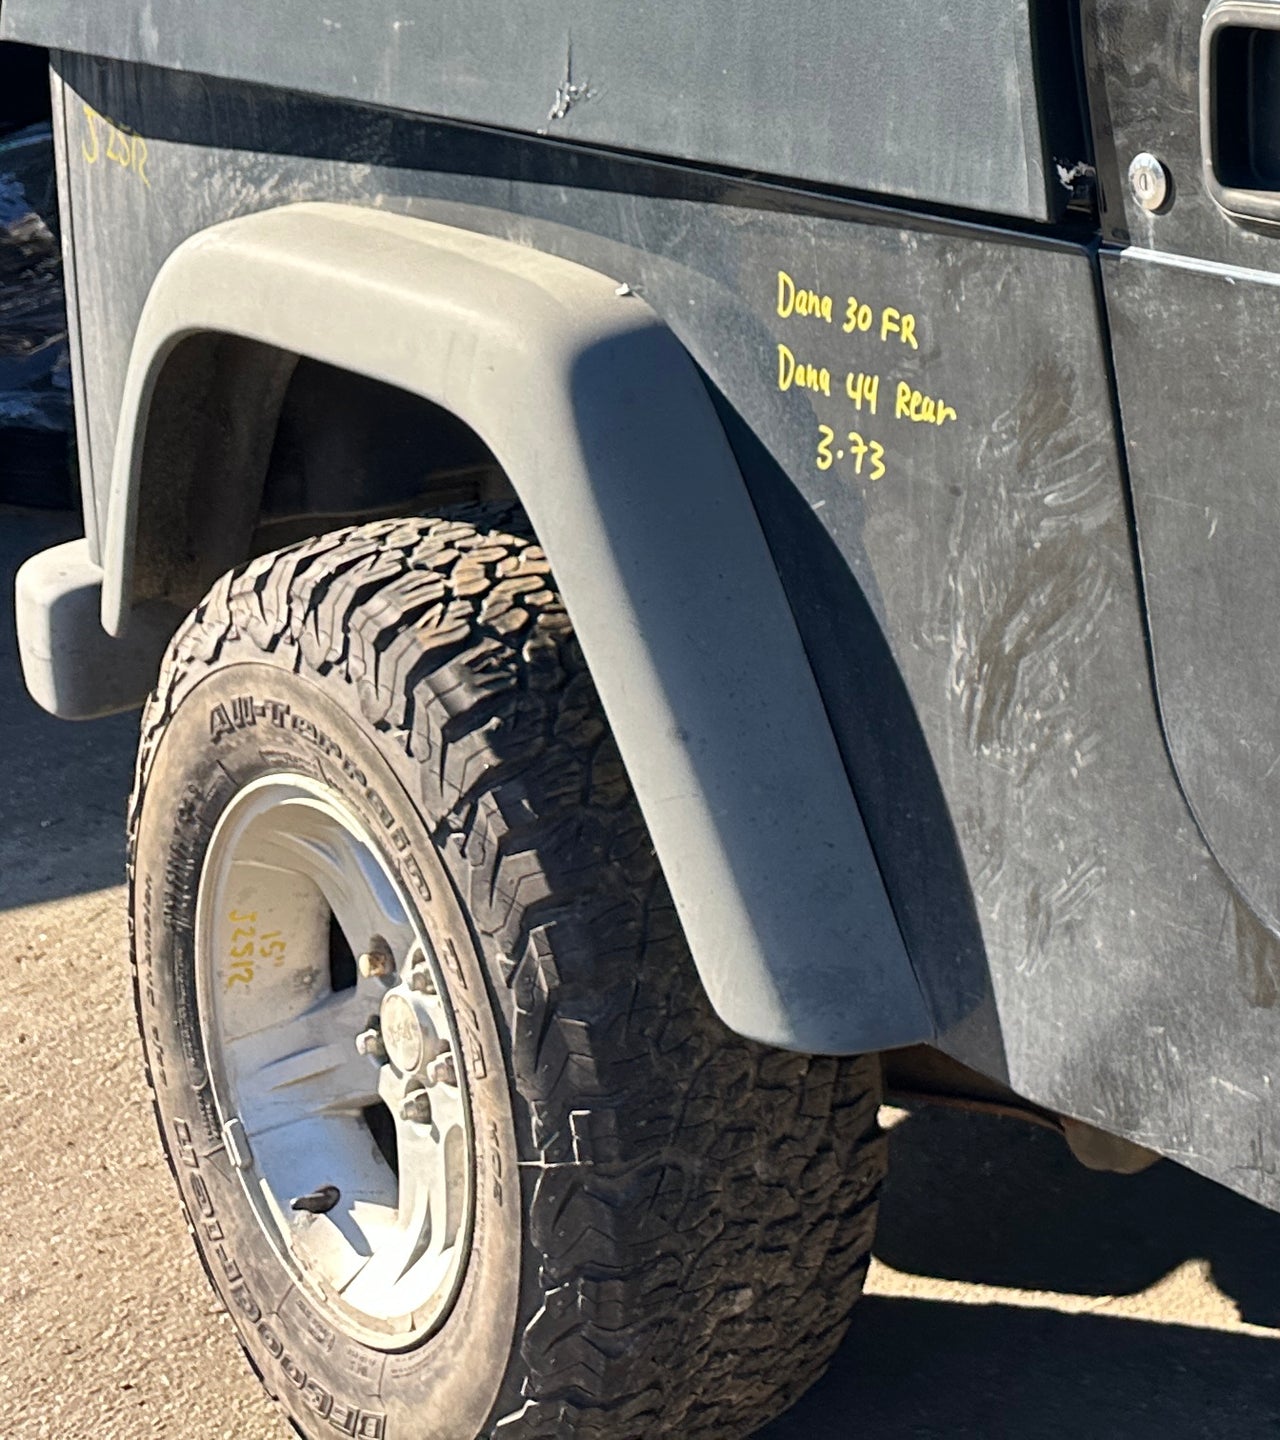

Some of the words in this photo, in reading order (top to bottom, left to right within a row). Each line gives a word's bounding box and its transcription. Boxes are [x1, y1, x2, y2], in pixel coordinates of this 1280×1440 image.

[777, 271, 832, 323] Dana
[843, 297, 873, 333] 30
[881, 307, 918, 350] FR
[778, 344, 831, 396] Dana
[847, 373, 879, 415] 44
[896, 381, 957, 426] Rear
[228, 909, 257, 989] J2512
